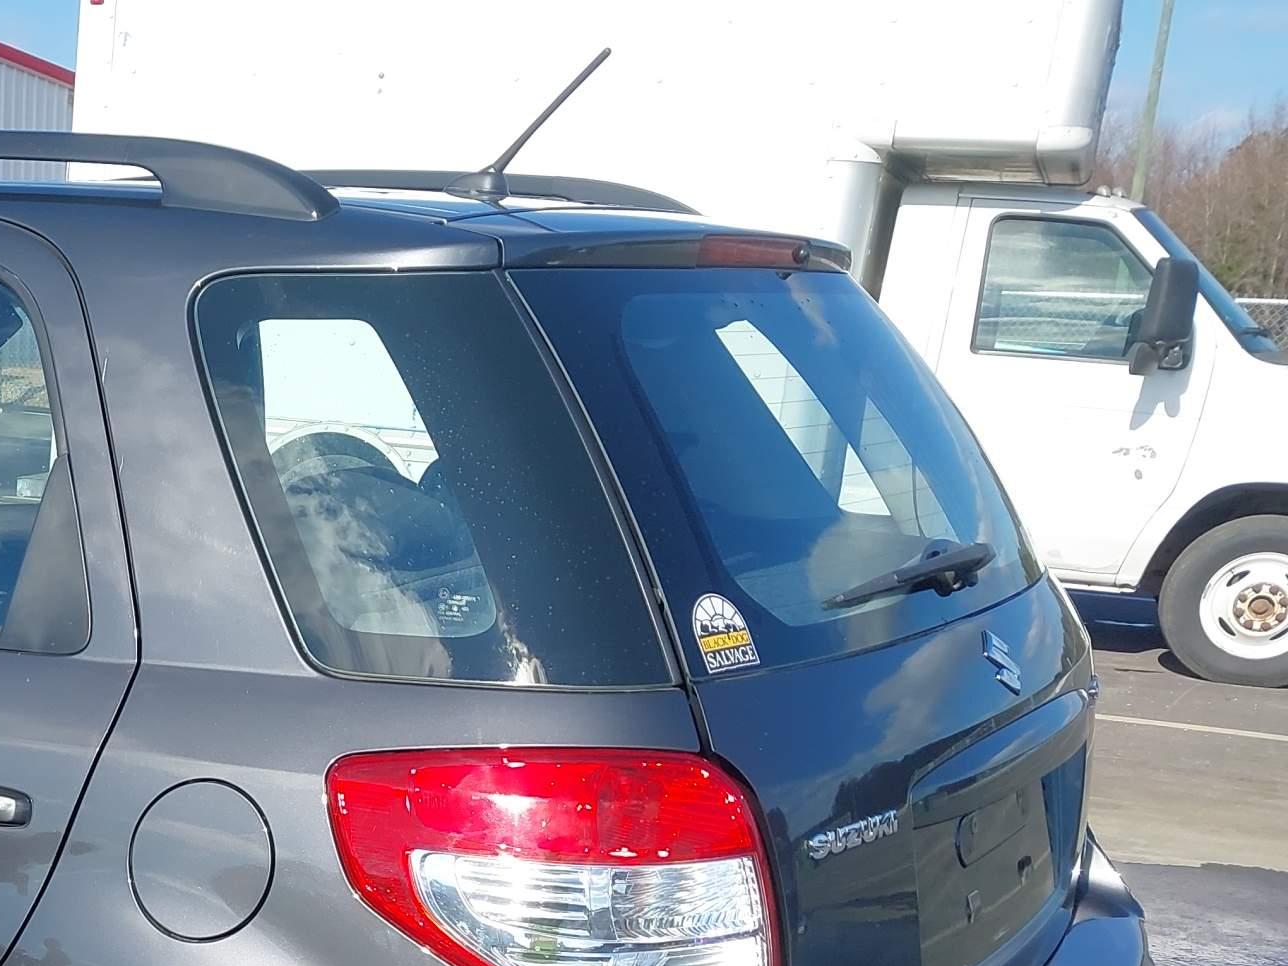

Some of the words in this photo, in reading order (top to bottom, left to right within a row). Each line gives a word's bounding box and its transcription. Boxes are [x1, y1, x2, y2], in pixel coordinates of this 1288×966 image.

[702, 636, 727, 650] BLACK
[731, 632, 749, 645] DOG
[706, 645, 756, 668] SALVAGE
[808, 810, 898, 860] SUZUKI
